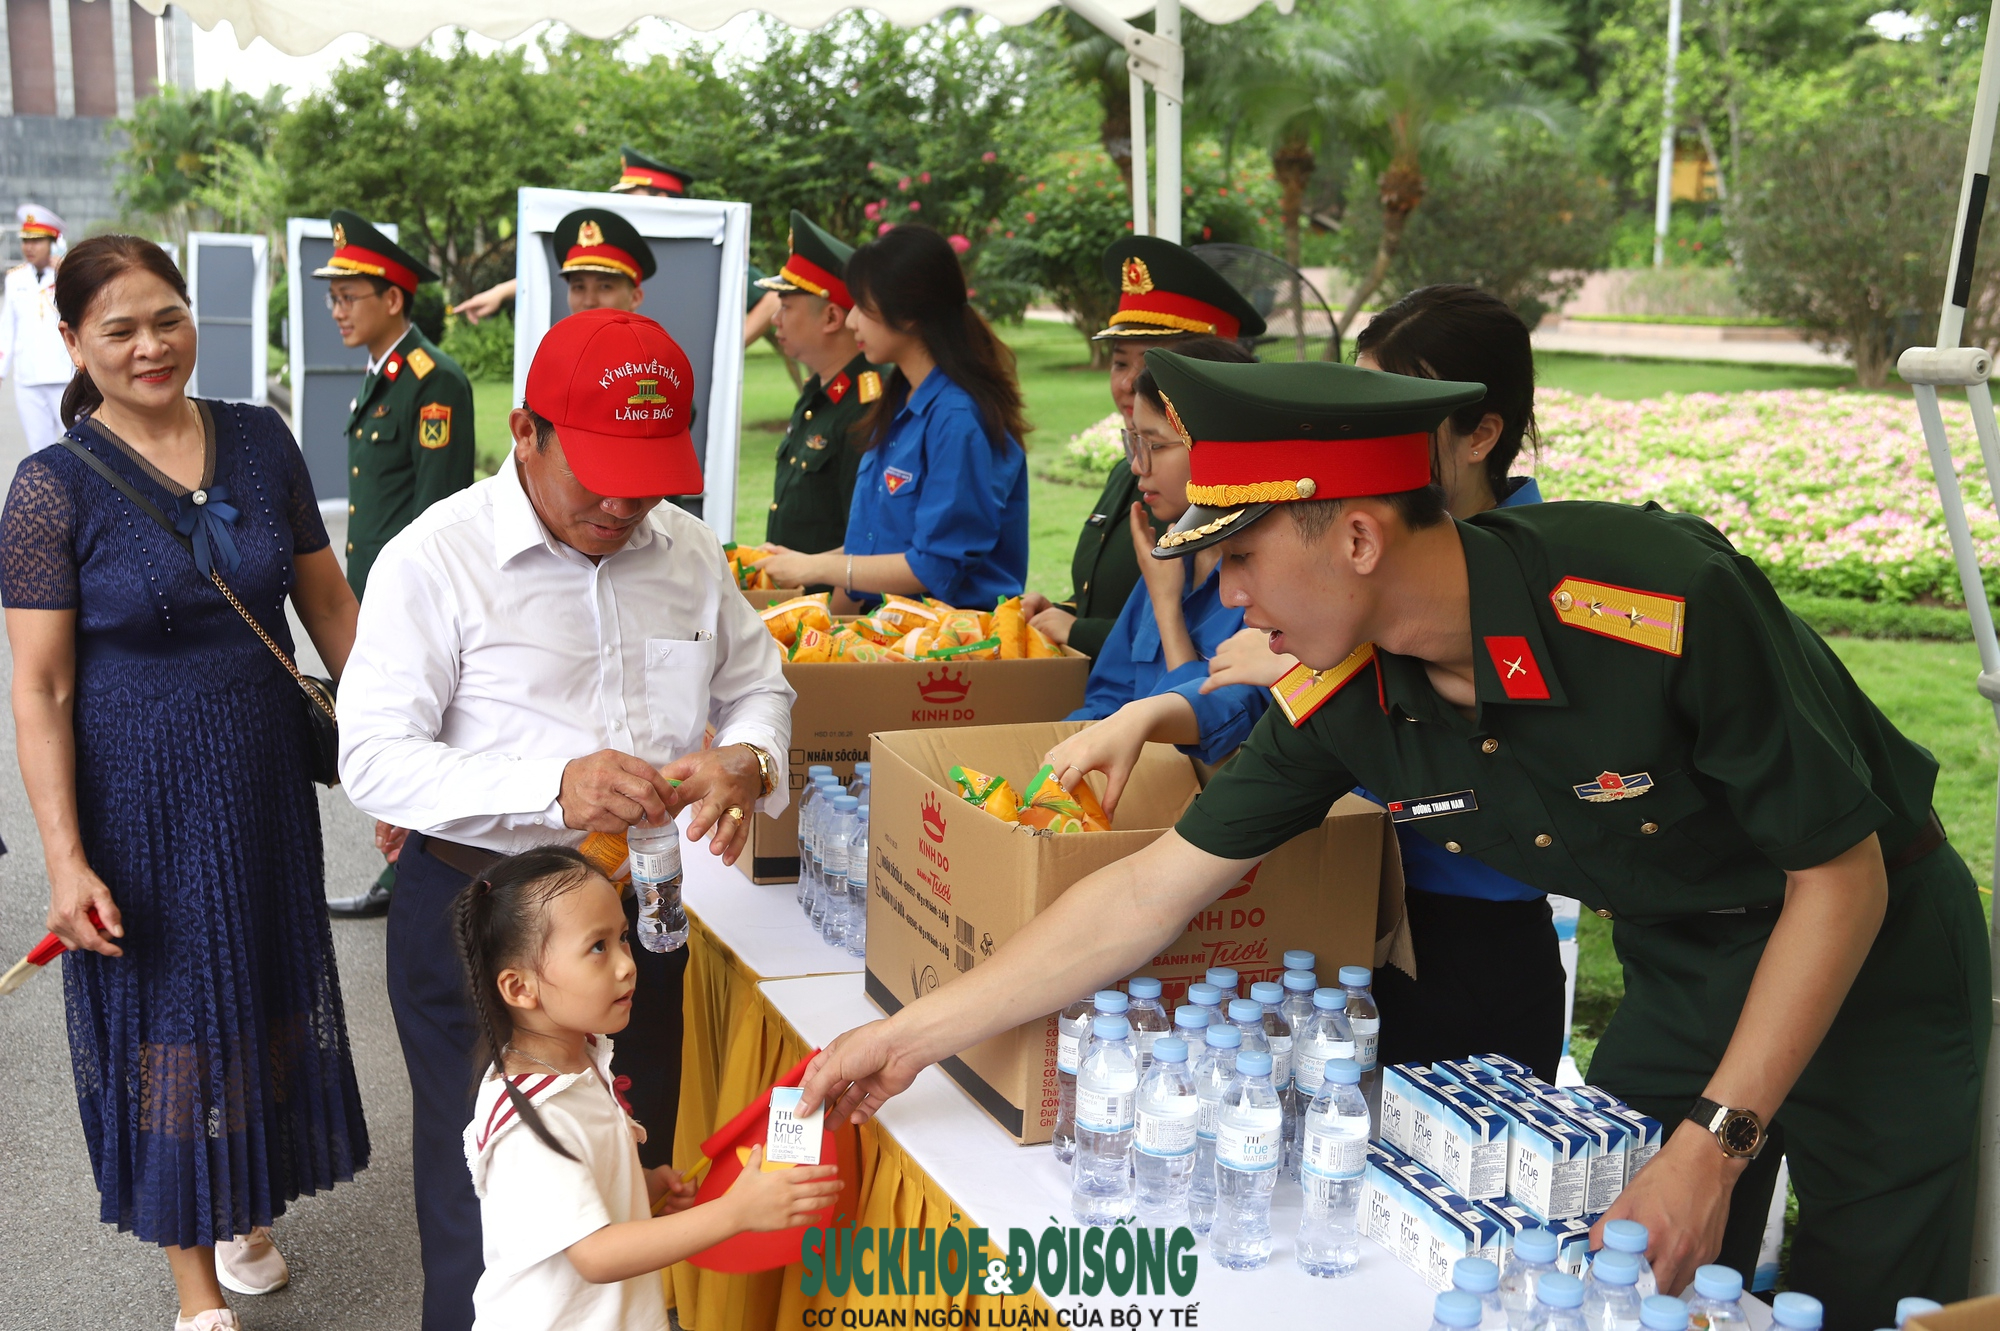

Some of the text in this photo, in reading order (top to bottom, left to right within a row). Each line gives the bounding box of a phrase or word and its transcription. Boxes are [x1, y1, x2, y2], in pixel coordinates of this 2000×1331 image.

[598, 358, 681, 389] KỶ NIỆM VỀ THĂM
[615, 404, 674, 420] LĂNG BÁC
[911, 709, 975, 722] KINH DO
[807, 749, 869, 762] NHÂN SÔCÔLA
[1431, 800, 1451, 812] THANH
[1450, 799, 1464, 809] NAM
[918, 837, 936, 864] KINH
[937, 854, 950, 872] DO
[930, 870, 951, 901] Tươi
[1188, 907, 1266, 932] NH DO
[1152, 937, 1269, 968] BÁNH MÌ Tươi
[1047, 1018, 1059, 1026] Sả
[1041, 1097, 1060, 1107] CÔN
[1385, 1090, 1395, 1103] TH
[776, 1110, 792, 1120] TH
[1040, 1108, 1058, 1117] Đườ
[1383, 1101, 1401, 1120] true
[1415, 1110, 1426, 1123] TH
[774, 1120, 803, 1134] true
[1383, 1113, 1400, 1131] MILK
[1414, 1121, 1432, 1141] true
[1445, 1130, 1455, 1142] TH
[773, 1133, 802, 1145] MILK
[1245, 1135, 1260, 1144] TH
[1413, 1132, 1431, 1151] MILK
[1243, 1144, 1268, 1155] true
[1444, 1141, 1460, 1159] true
[1521, 1148, 1532, 1162] TH
[1519, 1159, 1538, 1181] true
[1518, 1172, 1537, 1192] MILK
[1373, 1189, 1384, 1204] TH
[1372, 1200, 1390, 1221] true
[1400, 1222, 1419, 1244] true
[1429, 1246, 1448, 1270] true
